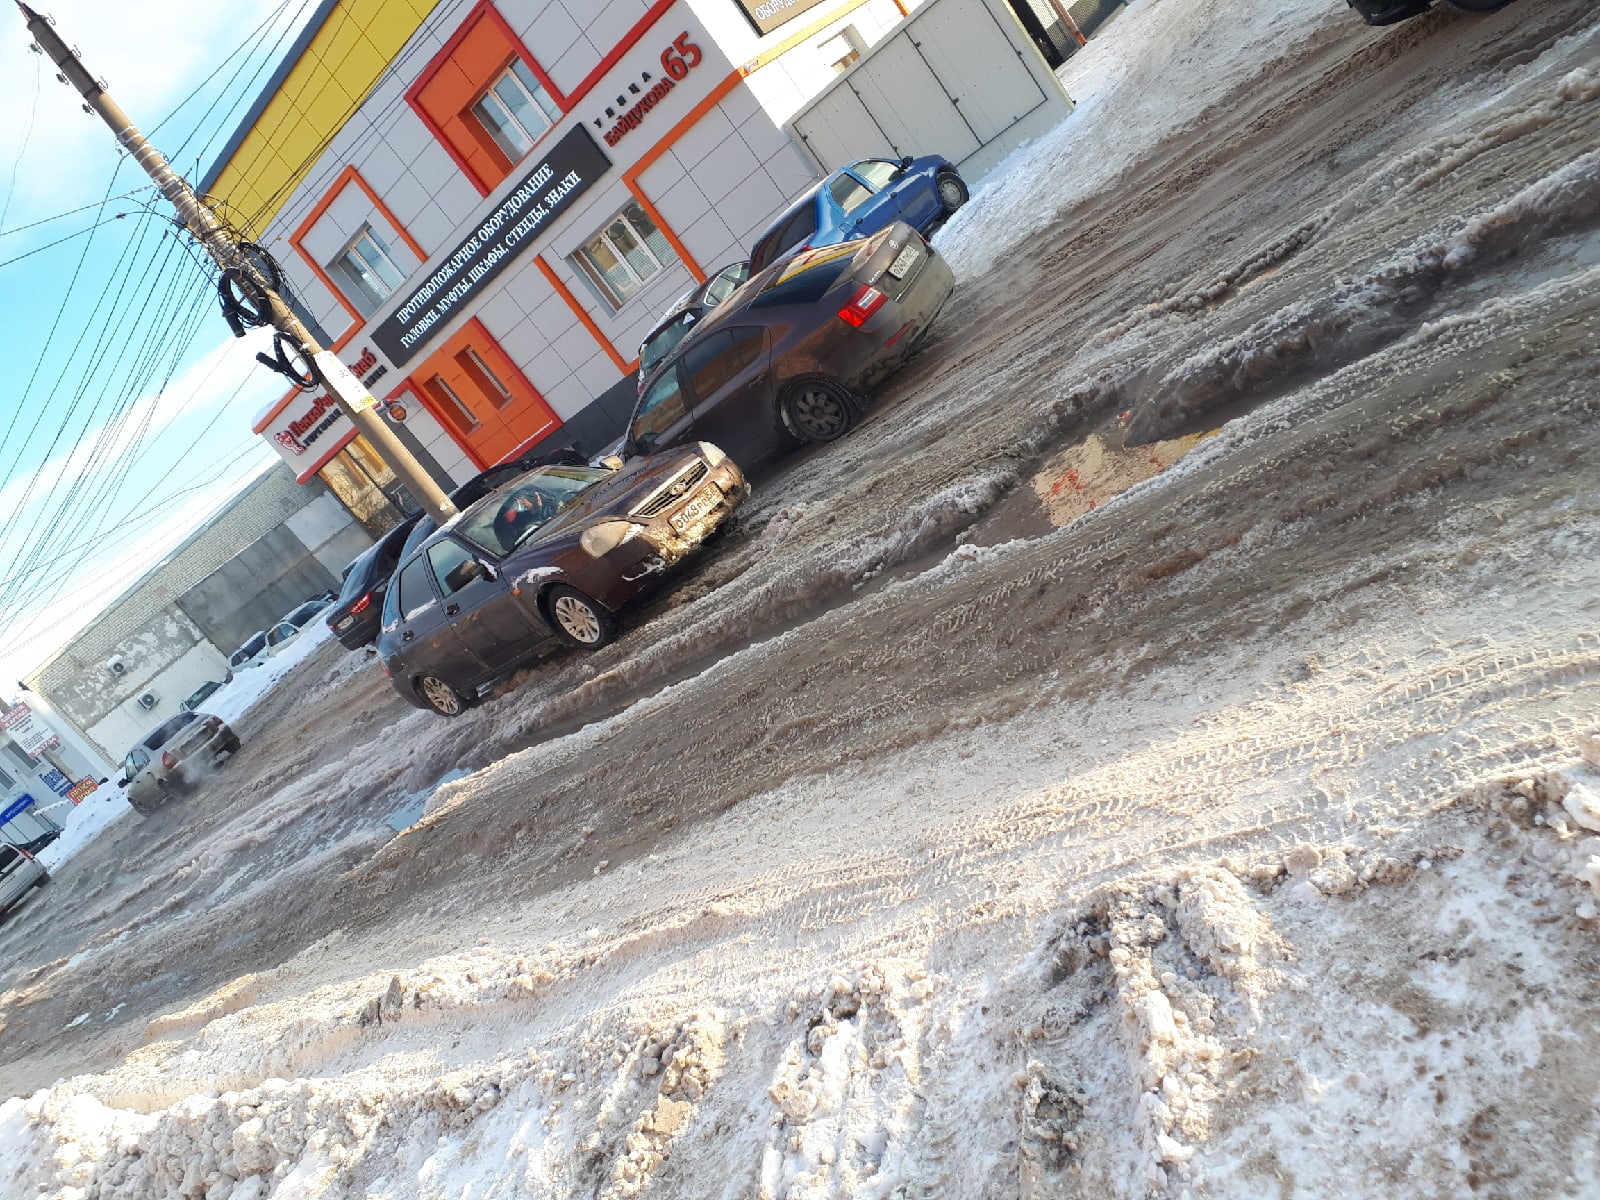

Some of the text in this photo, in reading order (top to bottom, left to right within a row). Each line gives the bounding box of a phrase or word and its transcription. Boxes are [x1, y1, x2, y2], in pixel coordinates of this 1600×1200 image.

[594, 72, 651, 128] УЛИЦА
[603, 31, 702, 148] БАЙДУКОВА 65
[544, 170, 582, 208] ЗНАКИ
[396, 162, 554, 325] ПРОТИВОПОЖАРНОЕ ОБОРУДОВАНИЕ
